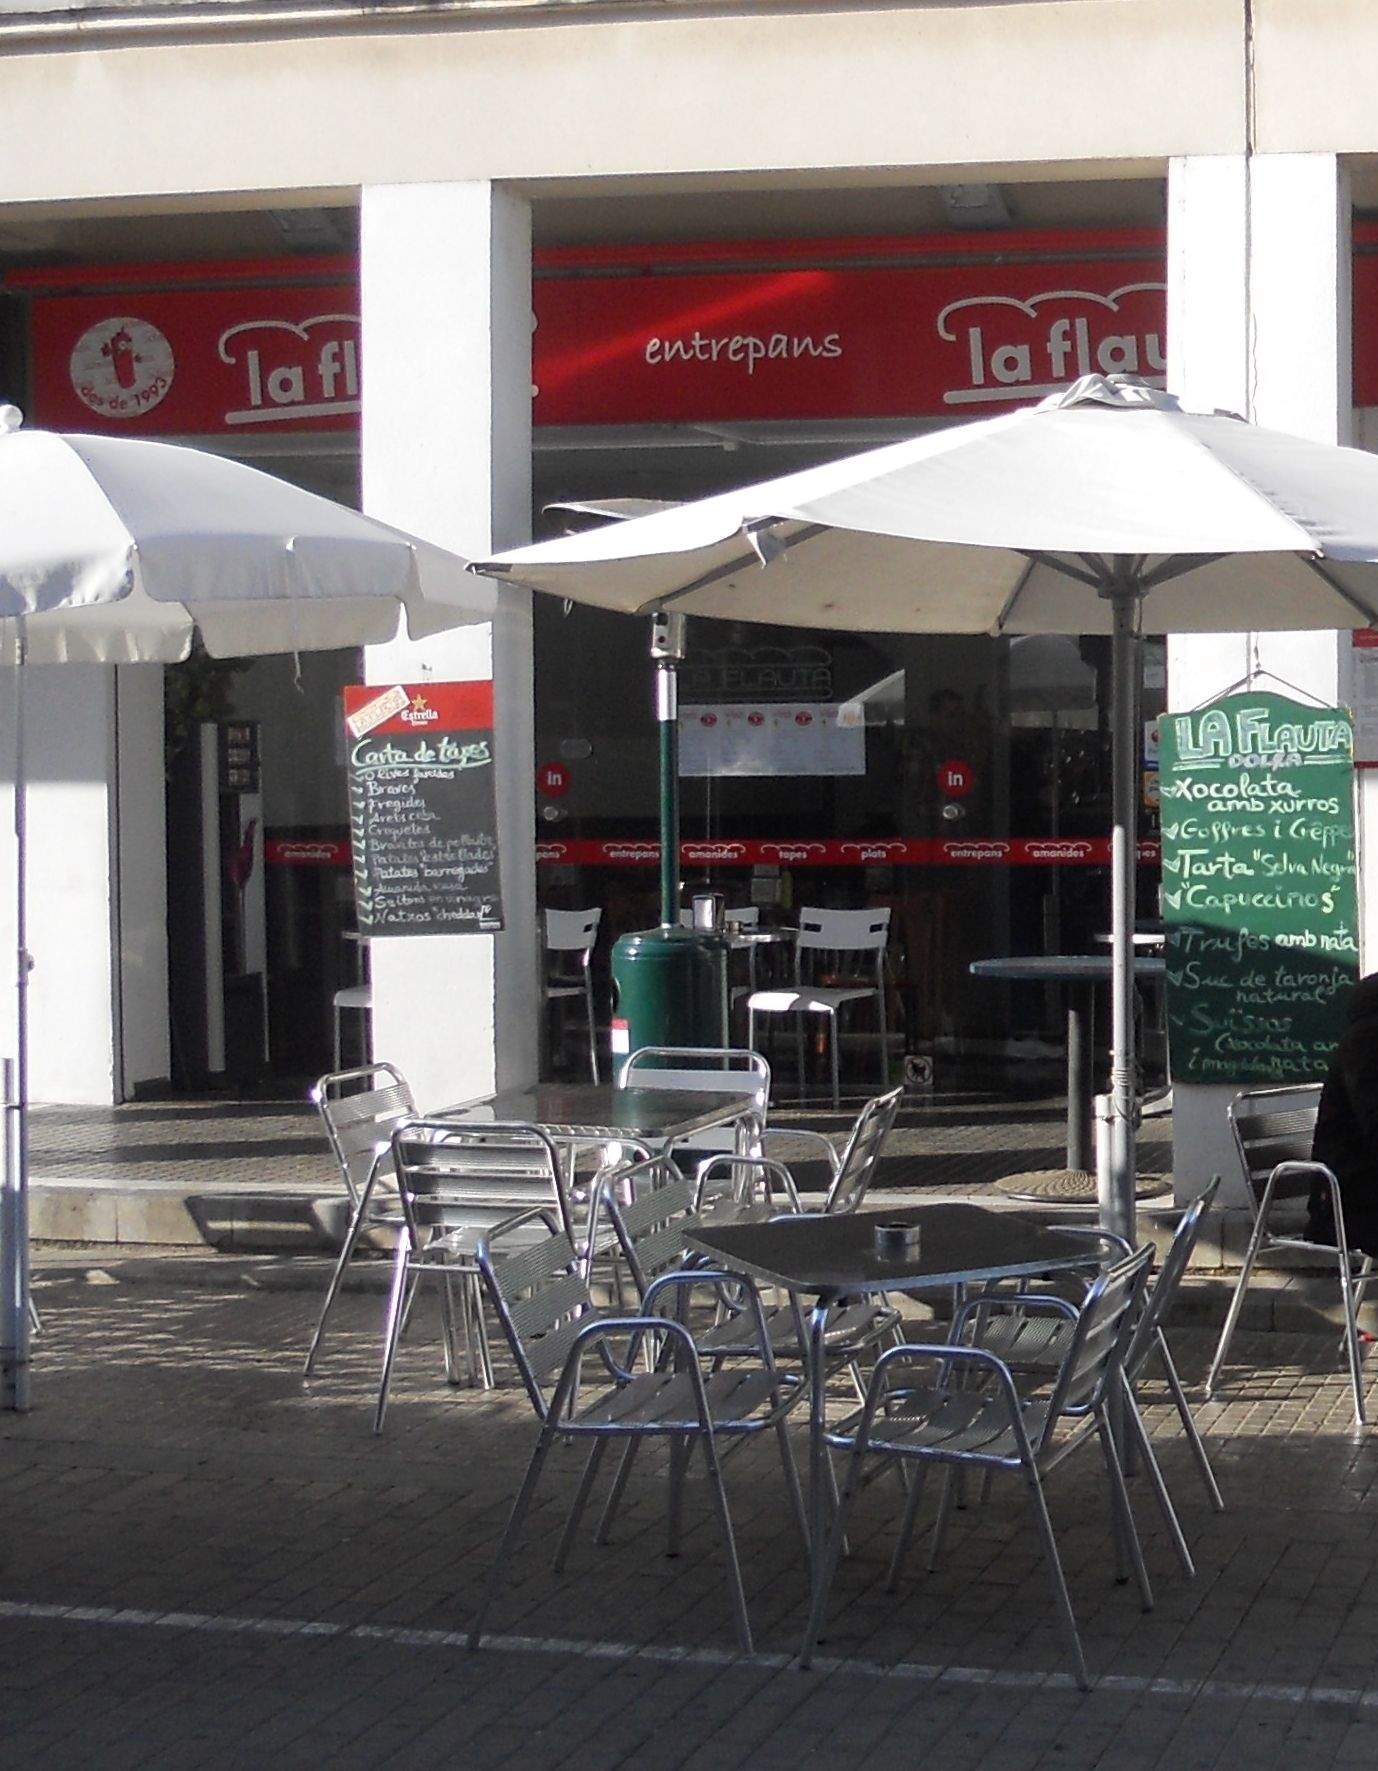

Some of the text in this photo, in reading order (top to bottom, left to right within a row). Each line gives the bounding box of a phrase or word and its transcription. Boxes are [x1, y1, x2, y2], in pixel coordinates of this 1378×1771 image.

[645, 331, 843, 375] entrepans
[968, 327, 1031, 385] la
[247, 350, 304, 406] la
[133, 376, 166, 407] 1993
[401, 709, 438, 722] Estrella
[1175, 708, 1353, 760] LA FLAUTA
[352, 739, 412, 766] Carta
[414, 742, 435, 761] de
[546, 771, 561, 785] in
[947, 772, 963, 786] in
[1175, 773, 1302, 801] Xocolata
[1207, 797, 1340, 814] amb xurros
[1274, 819, 1281, 839] i
[779, 850, 808, 863] tapes
[860, 849, 886, 863] plats
[950, 851, 1004, 863] entrepans
[1032, 850, 1084, 860] amanides
[1177, 849, 1254, 880] Tarta
[1178, 921, 1359, 963] Trufes amb nata
[1185, 961, 1354, 995] Suc de taronja
[1236, 985, 1328, 1005] natural
